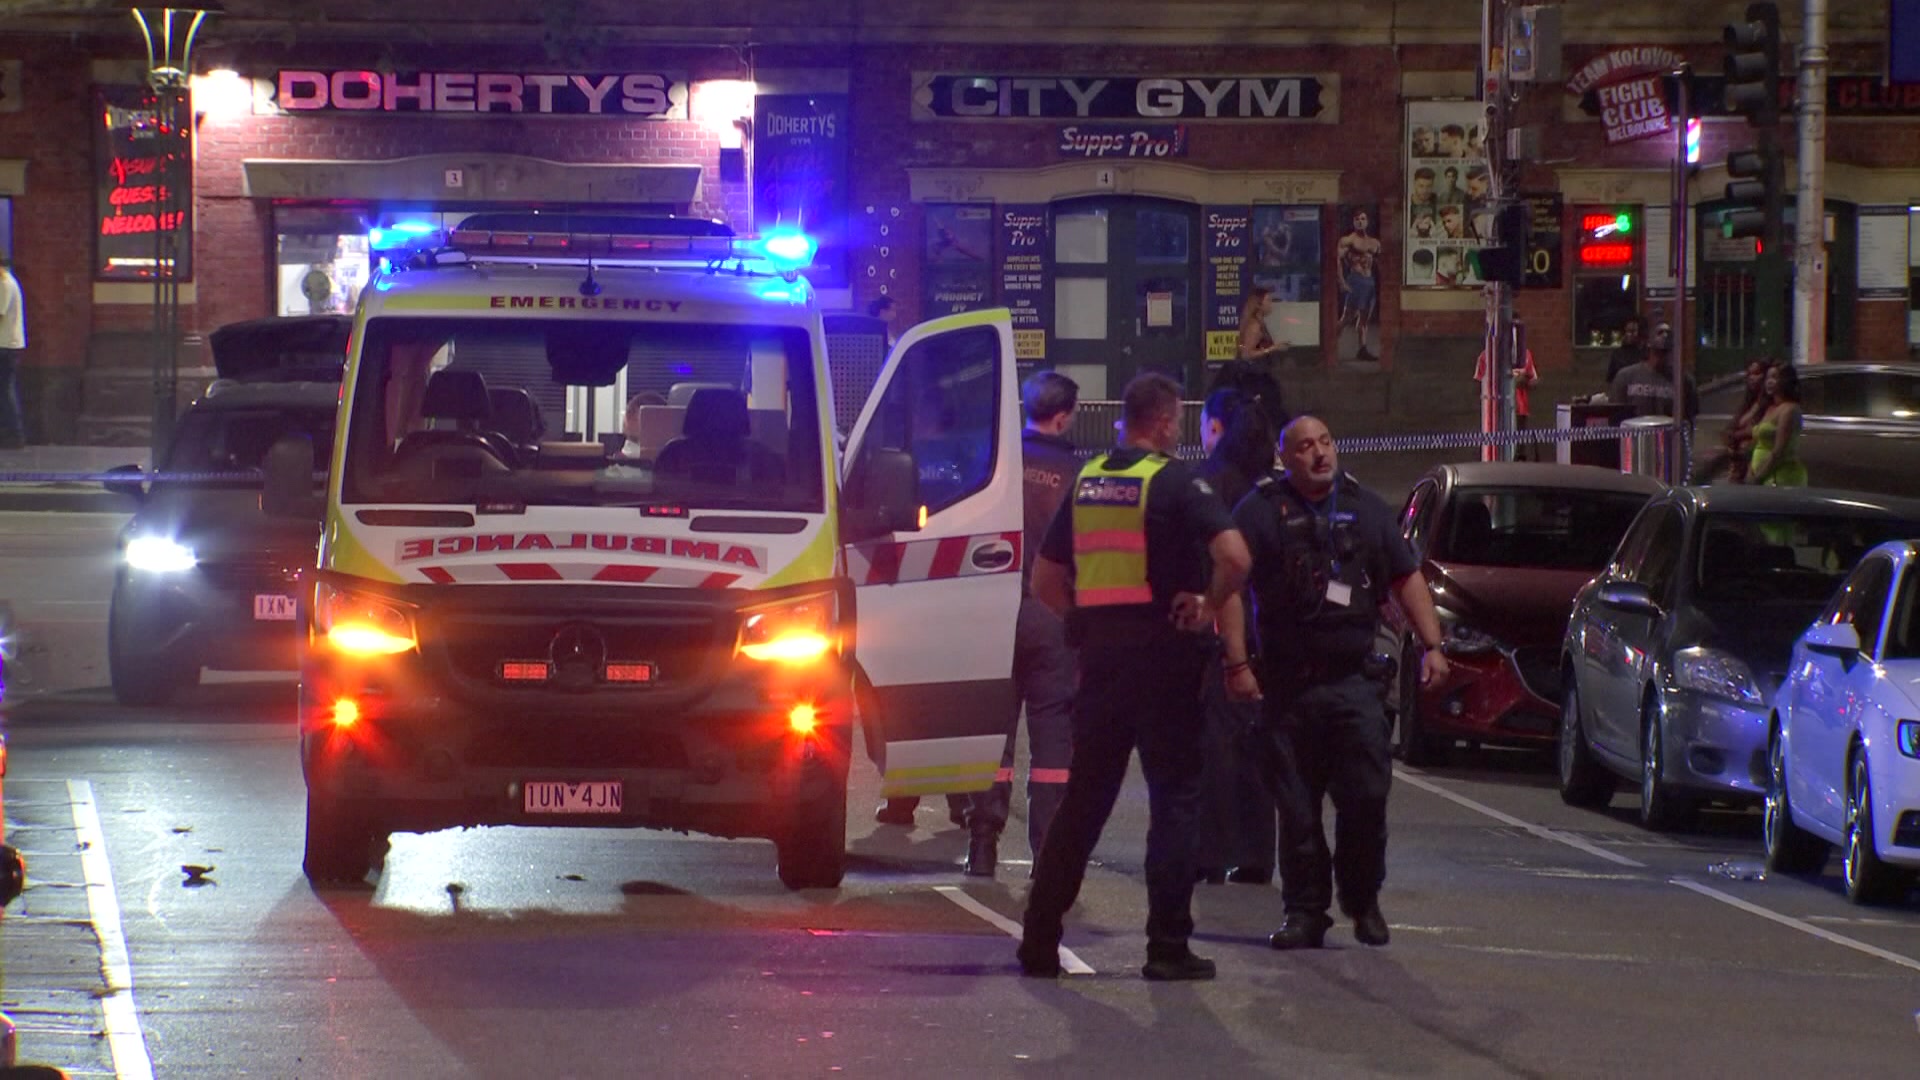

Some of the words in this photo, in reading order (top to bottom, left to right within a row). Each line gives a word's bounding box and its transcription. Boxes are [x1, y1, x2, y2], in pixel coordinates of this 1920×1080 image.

[277, 70, 667, 113] DOHERTYS
[951, 77, 1108, 118] CITY
[1135, 78, 1300, 118] GYM
[1600, 78, 1656, 107] FIGHT
[1602, 97, 1665, 127] CLUB
[767, 112, 836, 138] DOHERTYS
[790, 137, 812, 145] GYM
[1061, 126, 1125, 156] Supps
[1128, 131, 1169, 156] Pro
[451, 172, 458, 185] 3
[1101, 172, 1108, 184] 4
[1004, 211, 1042, 230] Supps
[1208, 213, 1247, 231] Supps
[1216, 231, 1240, 247] Pro
[1581, 246, 1631, 261] OPEN
[490, 296, 683, 312] EMERGENCY
